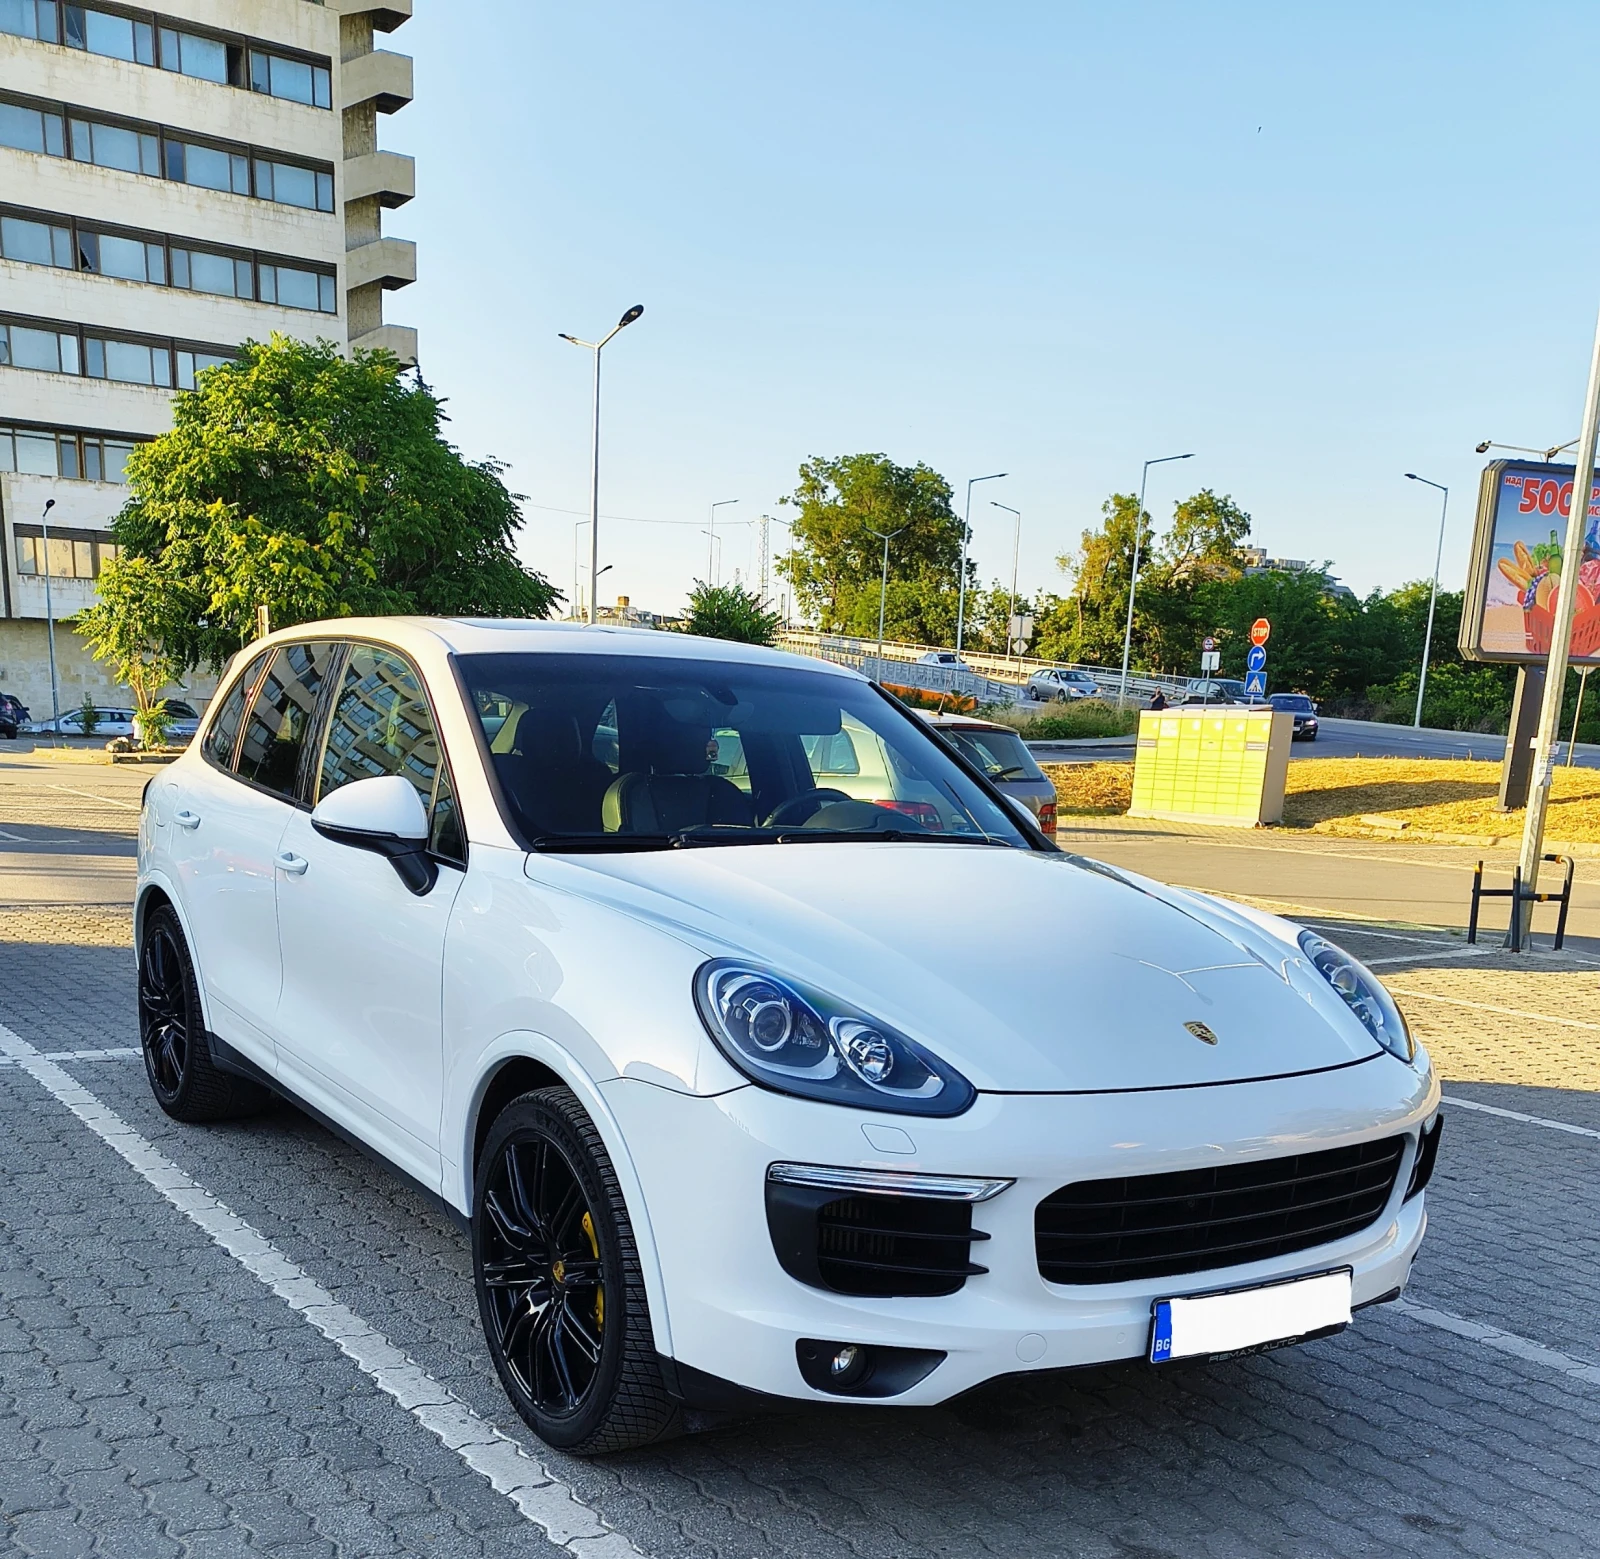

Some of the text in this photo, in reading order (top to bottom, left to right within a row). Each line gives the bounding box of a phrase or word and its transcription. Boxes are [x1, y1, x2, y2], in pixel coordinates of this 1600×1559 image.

[1253, 627, 1268, 637] STOP
[1155, 1338, 1170, 1352] BG
[1261, 1337, 1297, 1351] AUTO
